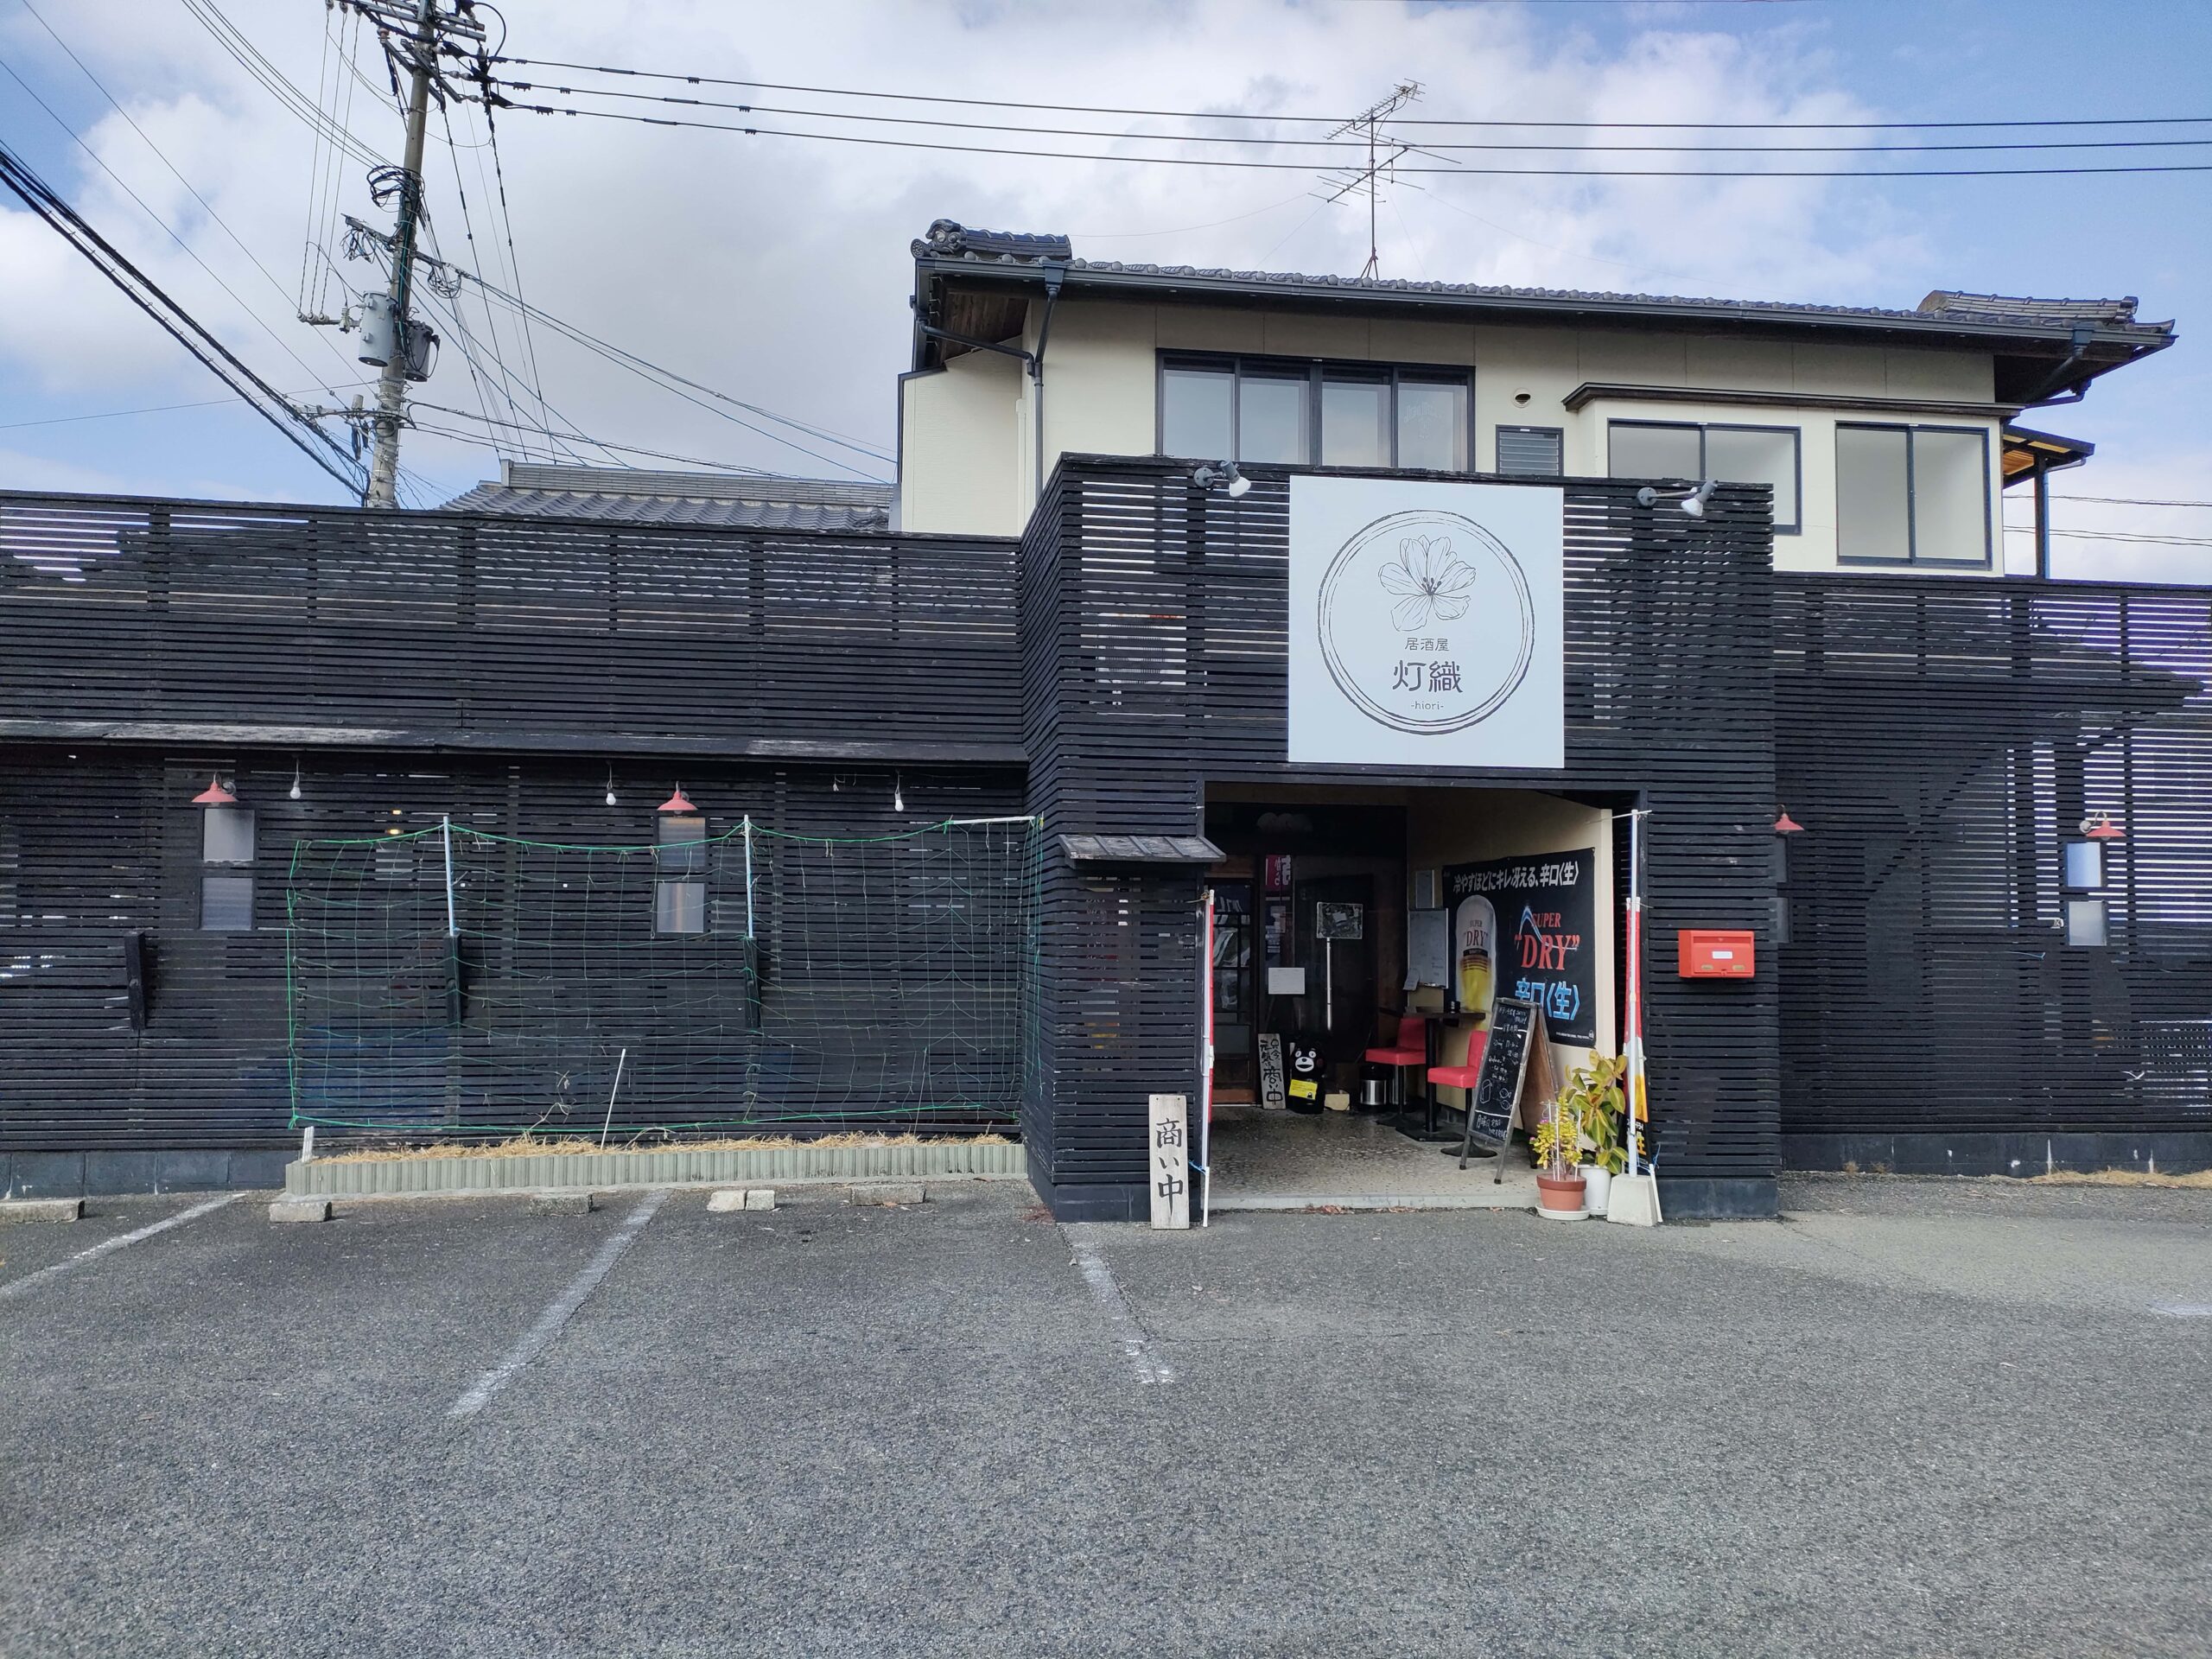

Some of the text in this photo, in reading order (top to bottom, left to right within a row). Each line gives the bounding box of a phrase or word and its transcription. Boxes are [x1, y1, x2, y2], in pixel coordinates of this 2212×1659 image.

[1405, 637, 1450, 652] 居酒屋
[1392, 659, 1464, 693] 灯織
[1531, 912, 1561, 928] SUPER
[1156, 1117, 1184, 1217] 商い中
